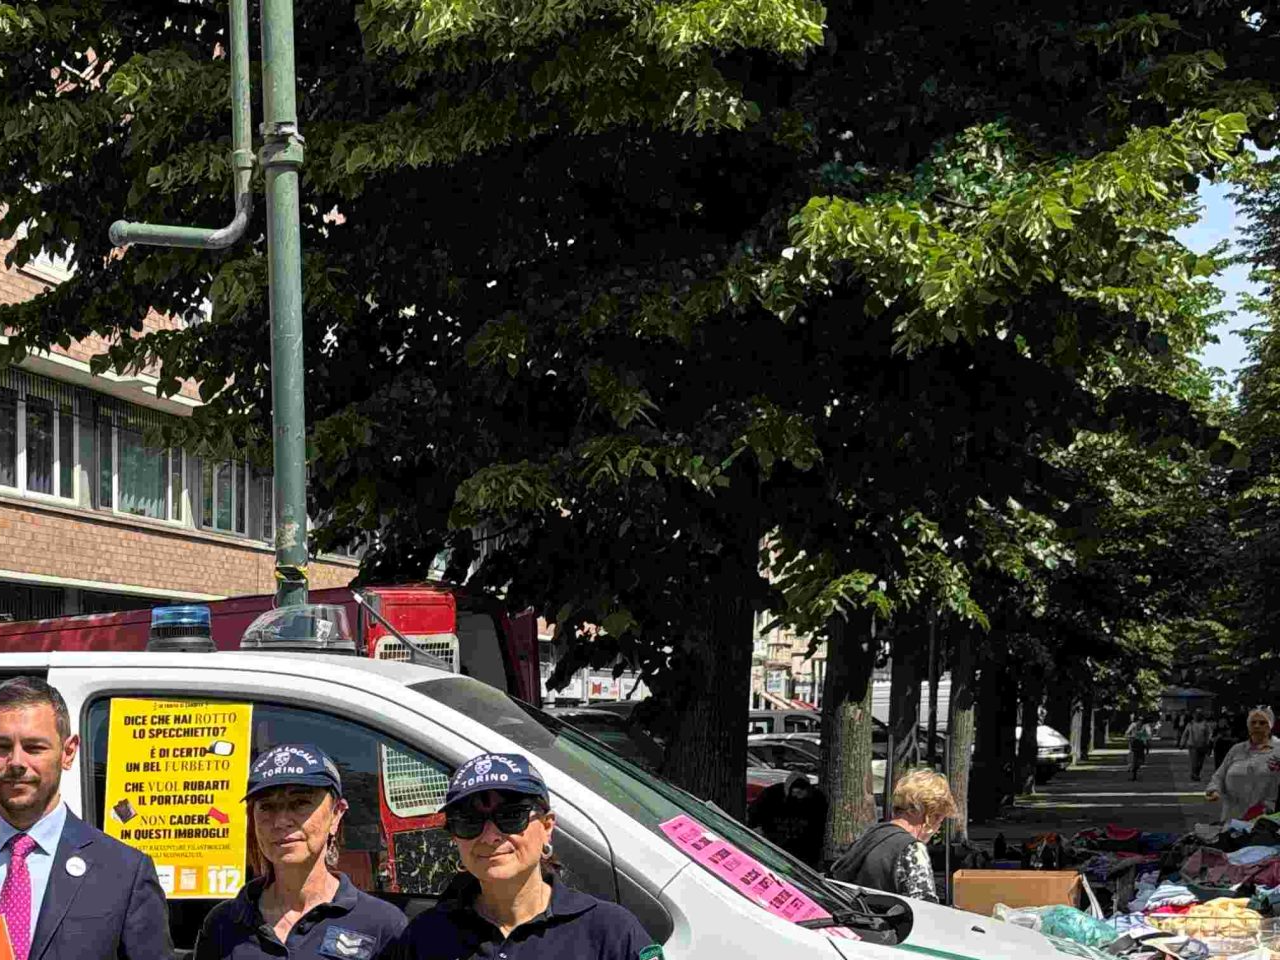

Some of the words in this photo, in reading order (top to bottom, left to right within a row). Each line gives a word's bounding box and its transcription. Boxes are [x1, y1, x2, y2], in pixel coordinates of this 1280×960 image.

[124, 715, 147, 726] DICE
[150, 714, 171, 725] CHE
[173, 713, 192, 725] HAI
[195, 712, 237, 724] ROTTO
[133, 728, 146, 739] LO
[148, 726, 227, 739] SPECCHIETTO?
[159, 747, 169, 758] DI
[172, 746, 208, 758] CERTO
[125, 762, 140, 772] UN
[143, 761, 162, 772] BEL
[165, 759, 230, 772] FURBETTO
[262, 766, 304, 778] TORINO
[124, 782, 145, 793] CHE
[183, 779, 230, 791] RUBARTI
[461, 773, 509, 788] TORINO
[138, 795, 147, 806] IL
[150, 794, 214, 806] PORTAFOGLI
[140, 814, 167, 826] NON
[169, 814, 211, 826] CADERE
[120, 829, 132, 840] IN
[134, 828, 171, 841] QUESTI
[174, 827, 229, 840] IMBROGLI!
[208, 868, 241, 894] 112
